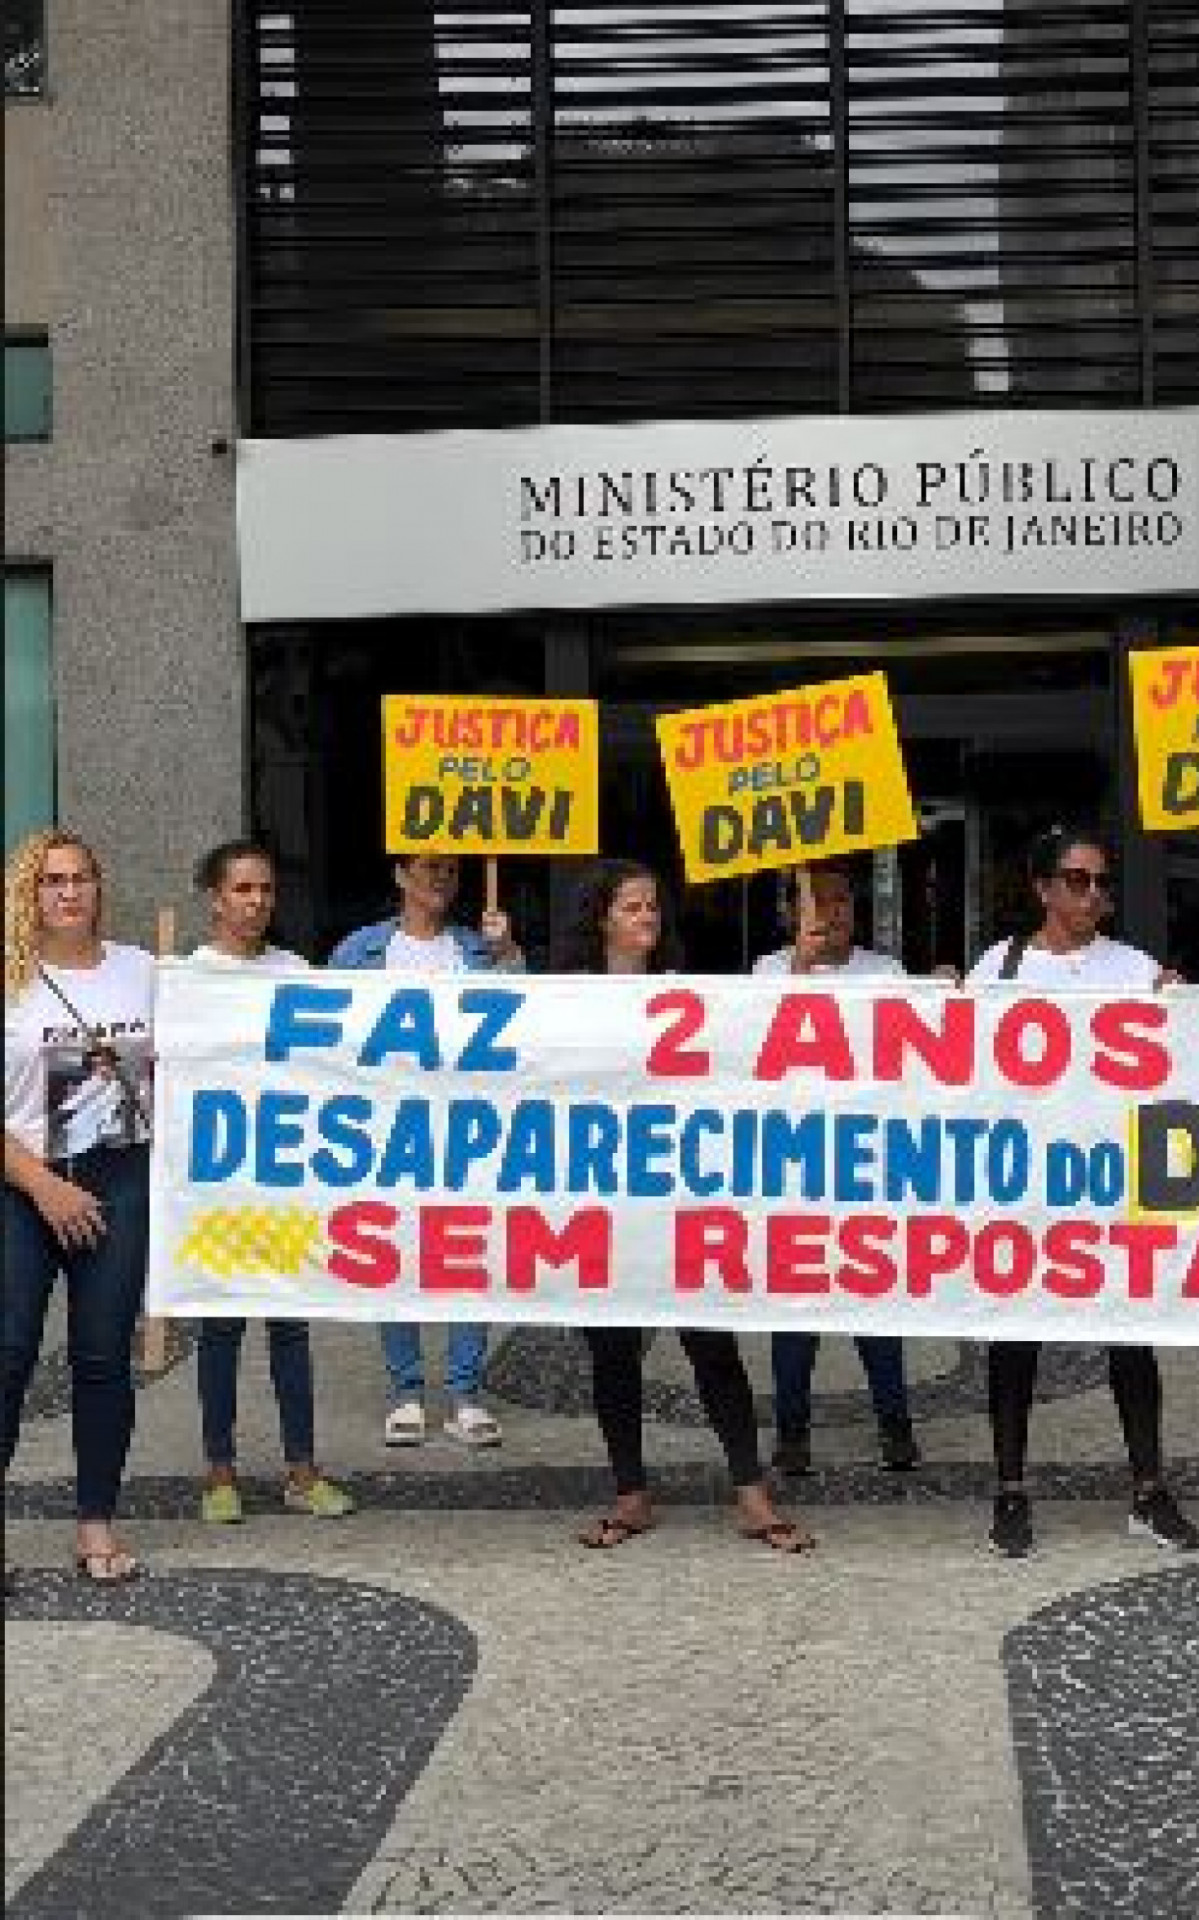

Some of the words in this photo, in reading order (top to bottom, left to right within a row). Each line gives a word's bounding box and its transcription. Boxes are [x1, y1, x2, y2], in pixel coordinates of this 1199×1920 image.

[520, 452, 889, 521] MINISTÉRIO
[917, 448, 1181, 506] PÚBLICO
[520, 529, 576, 560] DO
[592, 519, 754, 560] ESTADO
[771, 519, 830, 552] DO
[848, 515, 917, 551] RIO
[936, 514, 990, 551] DE
[1003, 511, 1183, 555] JANEIRO
[438, 756, 532, 783] PELO
[728, 752, 821, 796] PELO
[400, 785, 575, 840] DAVI
[703, 780, 865, 864] DAVI
[264, 983, 527, 1072] FAZ
[645, 989, 710, 1077] 2
[753, 993, 1173, 1091] ANOS
[188, 1088, 1030, 1204] DESAPARECIMENTO
[1045, 1138, 1125, 1207] DO
[326, 1201, 611, 1293] SEM
